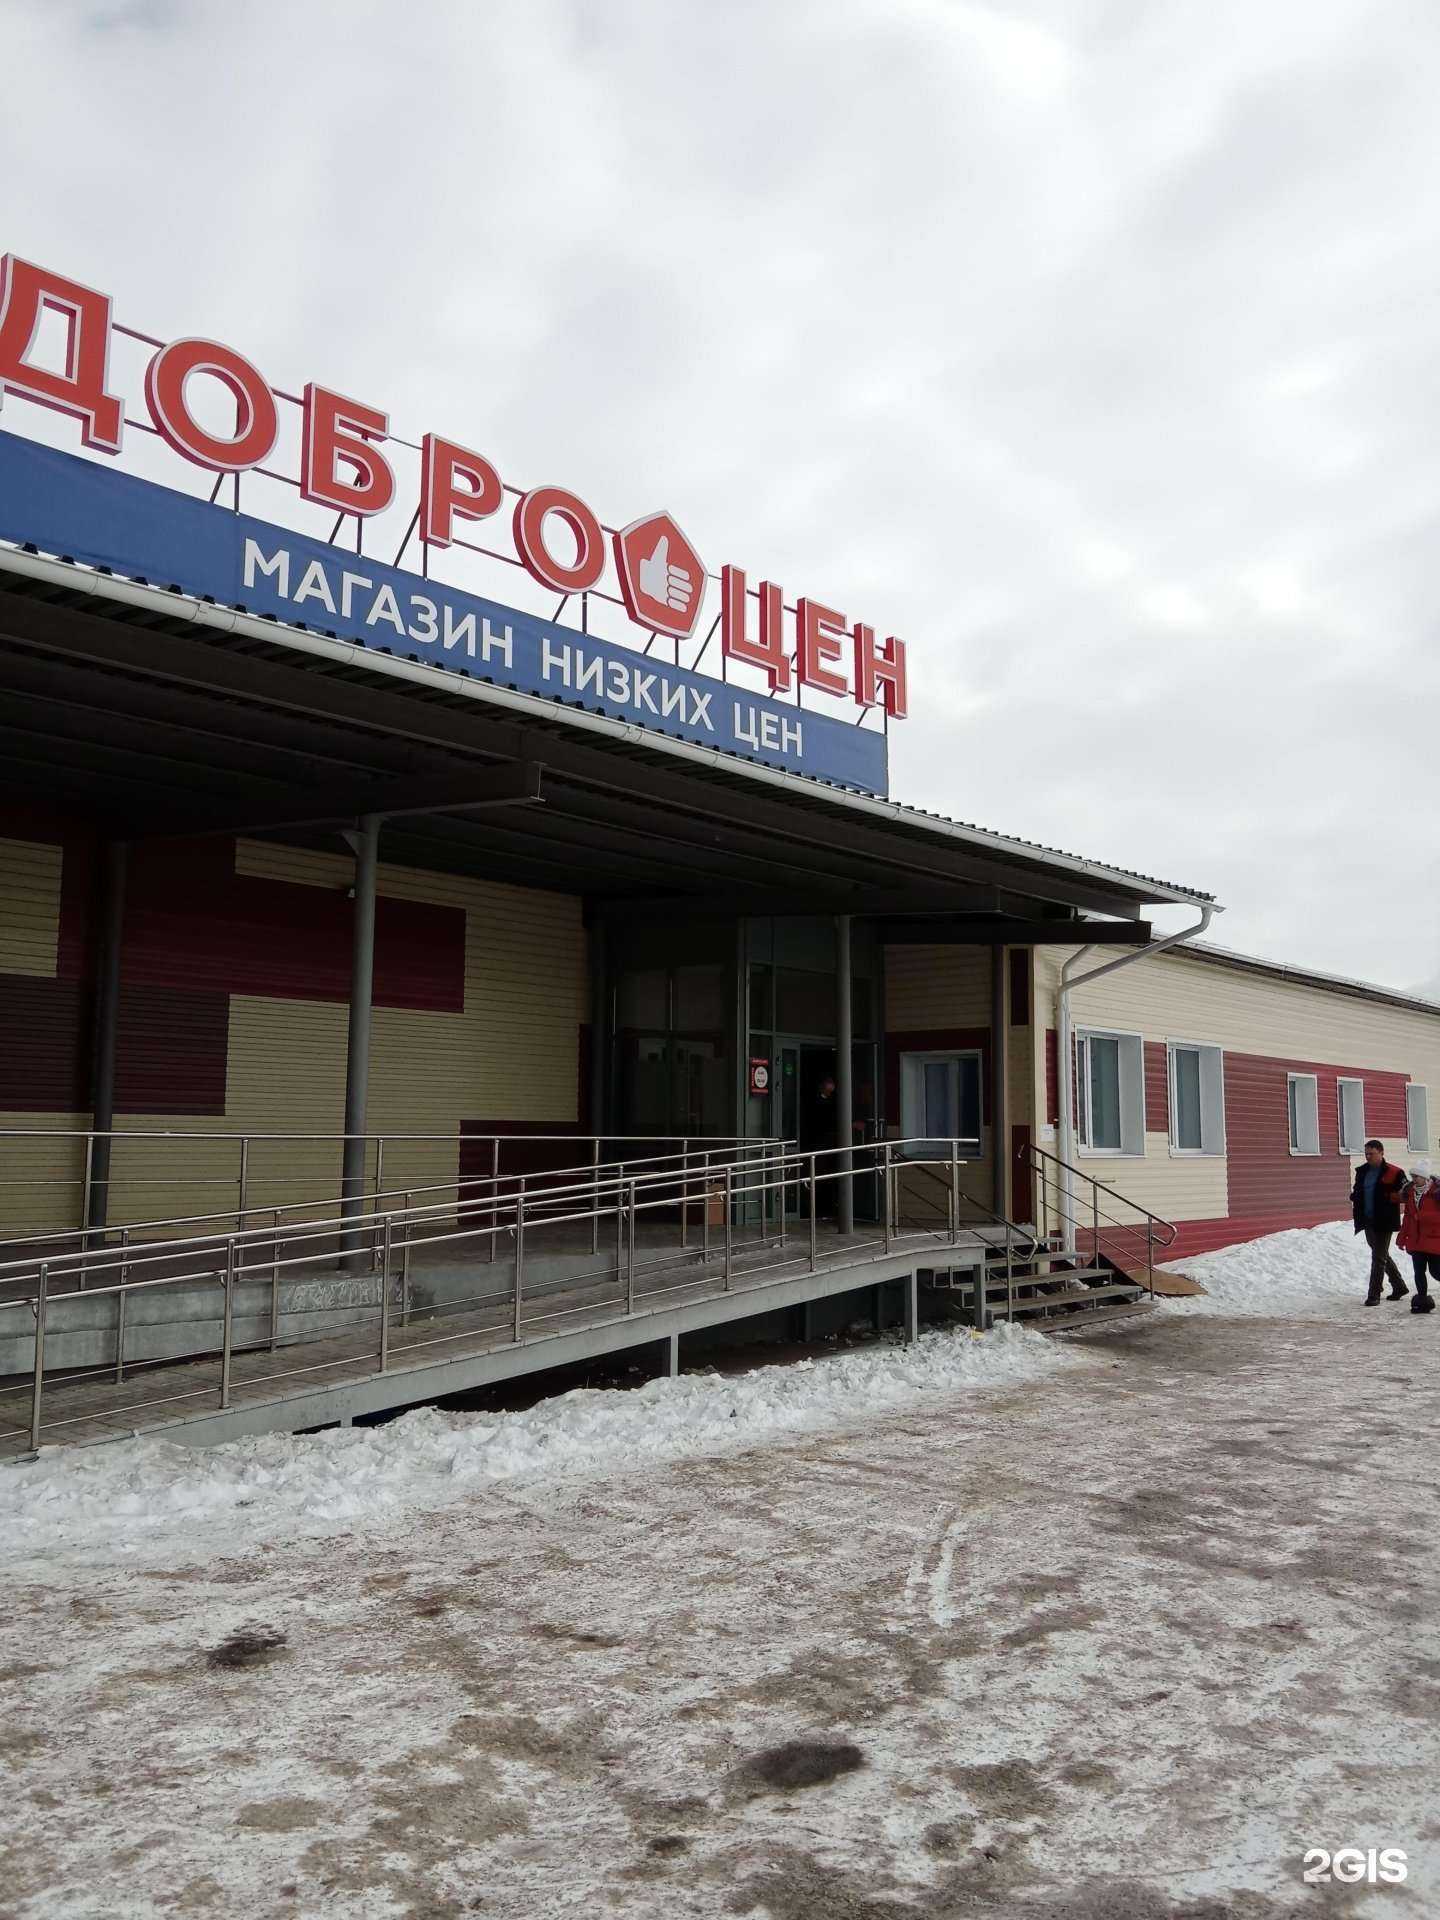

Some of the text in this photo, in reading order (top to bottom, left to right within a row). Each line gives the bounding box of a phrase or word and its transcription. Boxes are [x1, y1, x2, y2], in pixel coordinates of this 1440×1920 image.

[243, 538, 802, 757] МАГАЗИН НИЗКИХ ЦЕН
[722, 564, 907, 719] ЦЕН
